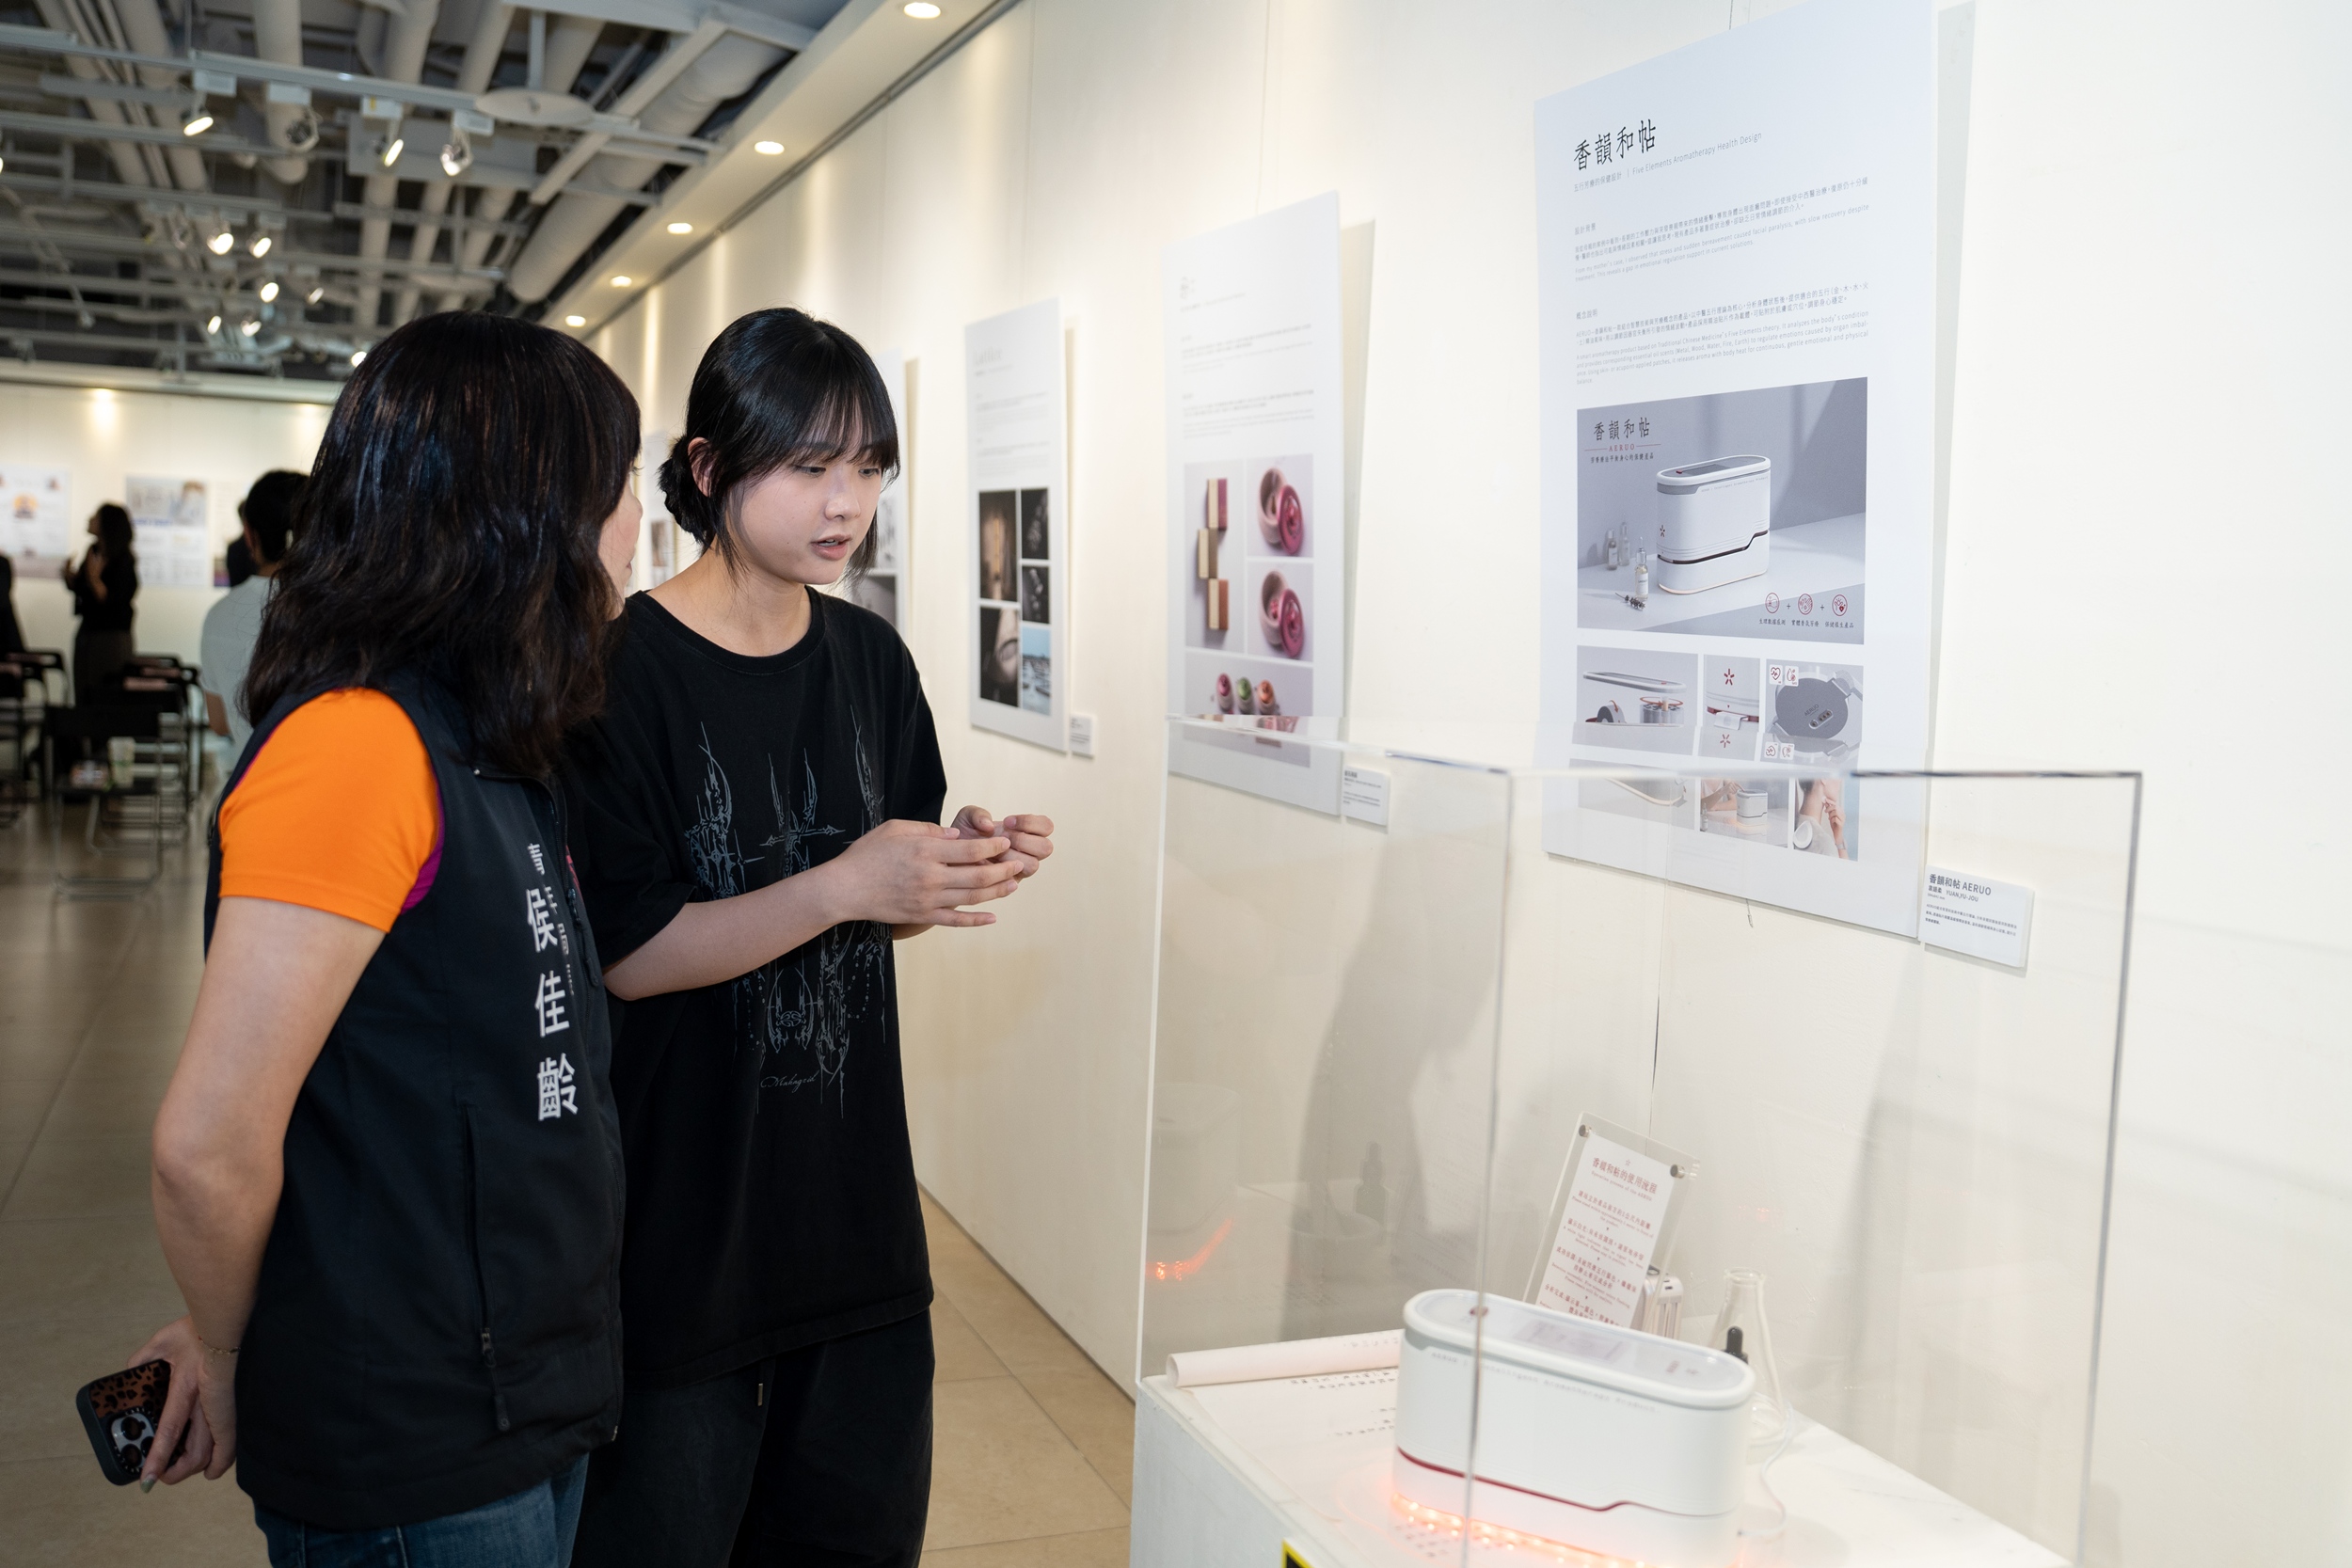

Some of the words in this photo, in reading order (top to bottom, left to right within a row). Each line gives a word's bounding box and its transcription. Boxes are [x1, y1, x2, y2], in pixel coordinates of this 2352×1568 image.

[1574, 119, 1656, 171] 香韻和帖
[1632, 165, 1645, 175] Five
[1645, 156, 1672, 171] Elements
[1674, 144, 1716, 166] Aromatherapy
[1717, 137, 1738, 151] Health
[1740, 131, 1762, 147] Design
[1594, 417, 1650, 441] 香韻和帖
[1609, 443, 1635, 451] AERUO
[1929, 873, 1962, 890] 香韻和帖
[1962, 881, 1993, 896] AERUO
[526, 888, 579, 1121] 侯佳齡
